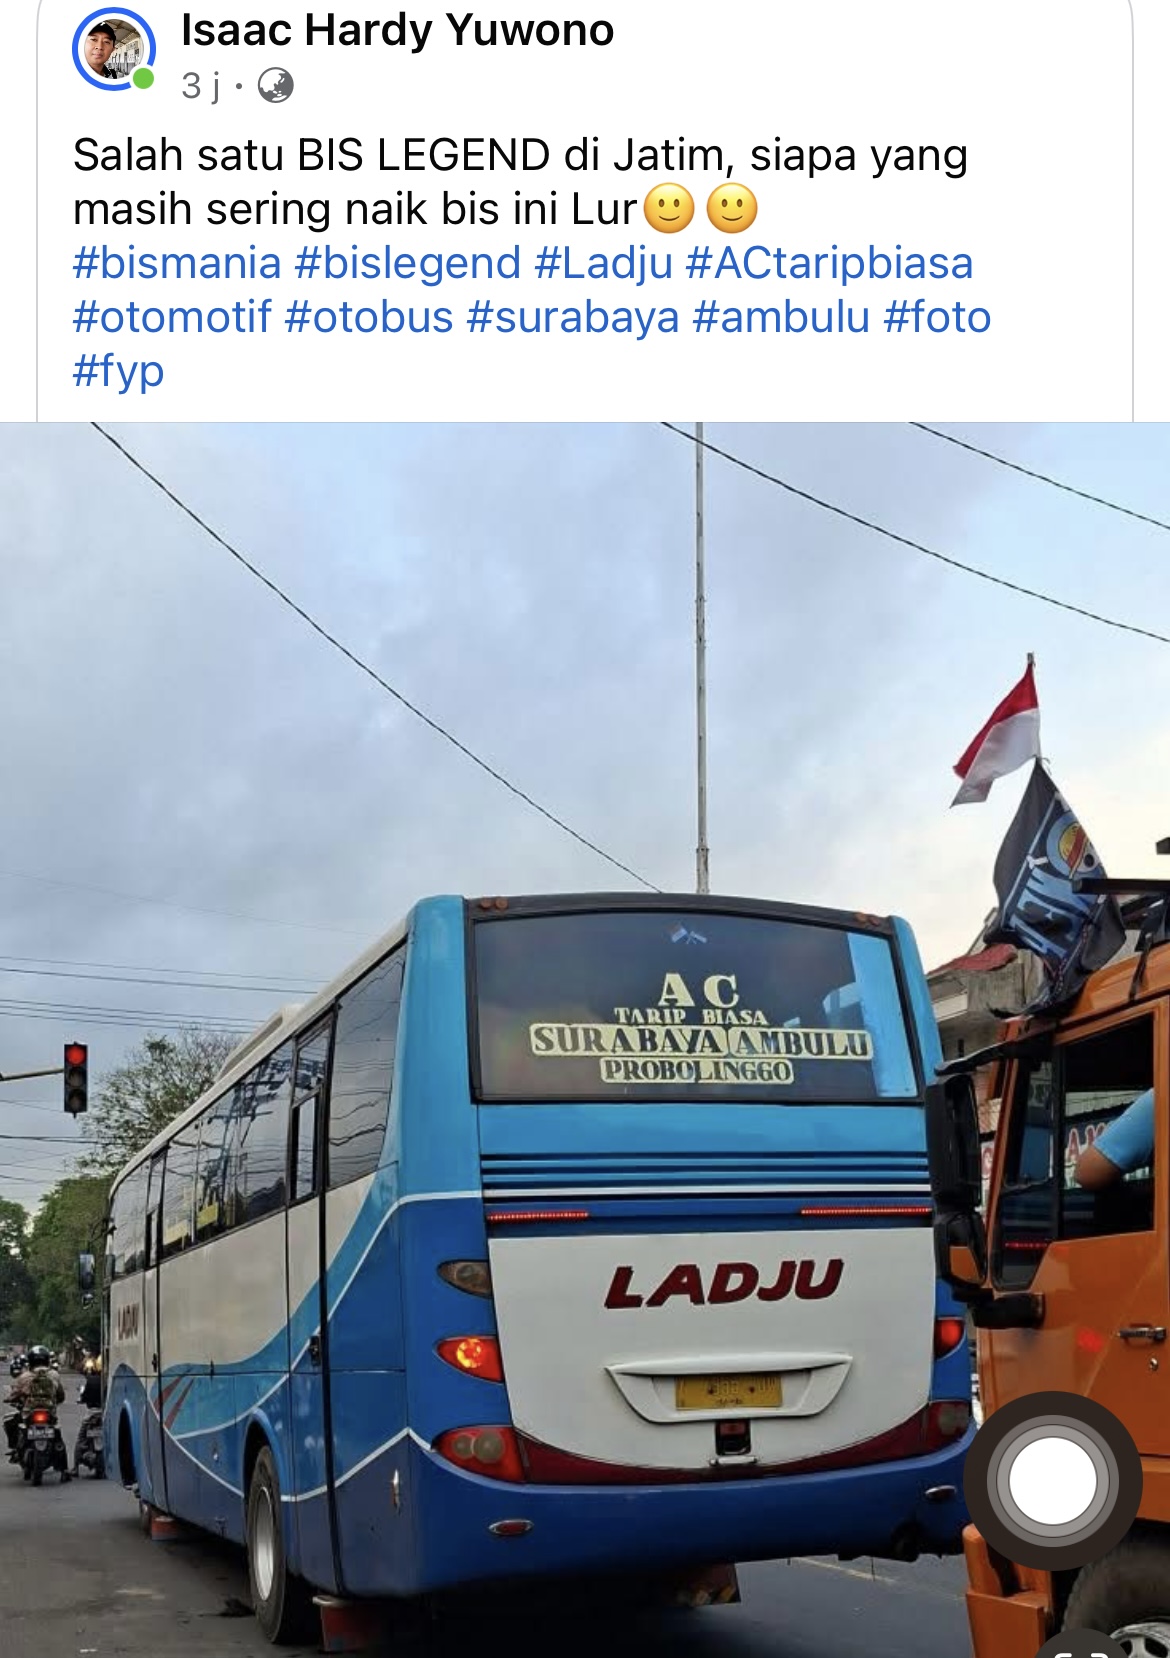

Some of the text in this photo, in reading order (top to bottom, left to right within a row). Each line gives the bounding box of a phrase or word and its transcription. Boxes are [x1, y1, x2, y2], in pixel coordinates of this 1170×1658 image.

[614, 1007, 769, 1026] TARIP BIASA
[533, 1026, 869, 1057] SURABAYA AMBULU
[605, 1058, 792, 1082] PROBOLINGGO
[604, 1258, 844, 1309] LADJU
